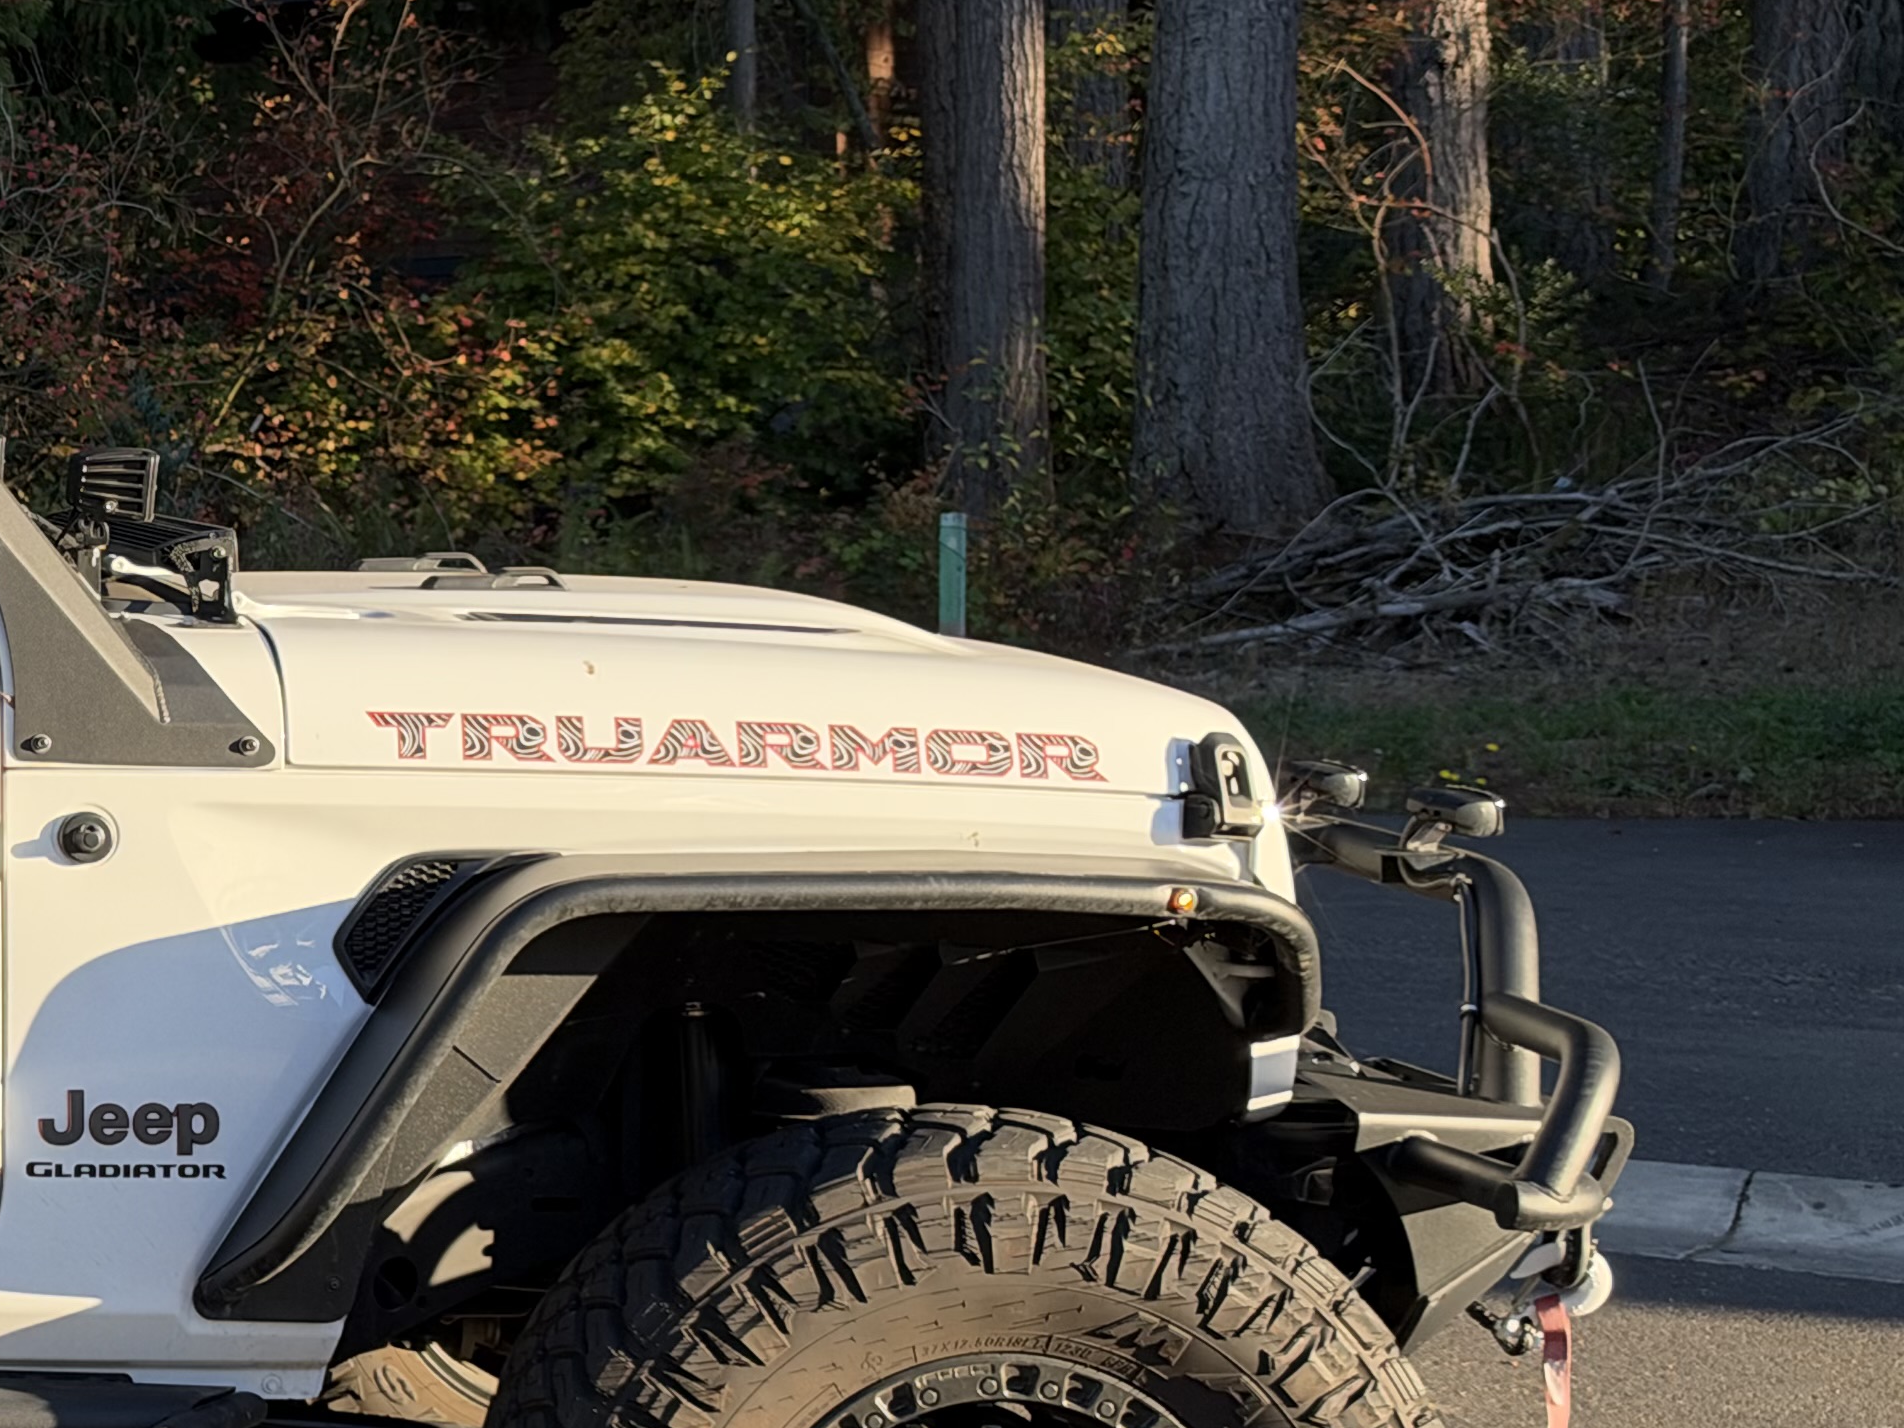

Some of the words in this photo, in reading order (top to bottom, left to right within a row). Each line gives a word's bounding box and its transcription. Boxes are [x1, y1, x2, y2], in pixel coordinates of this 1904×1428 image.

[365, 709, 1110, 784] TRUARMOR
[37, 1088, 221, 1156] Jeep
[25, 1161, 228, 1180] GLADIATOR
